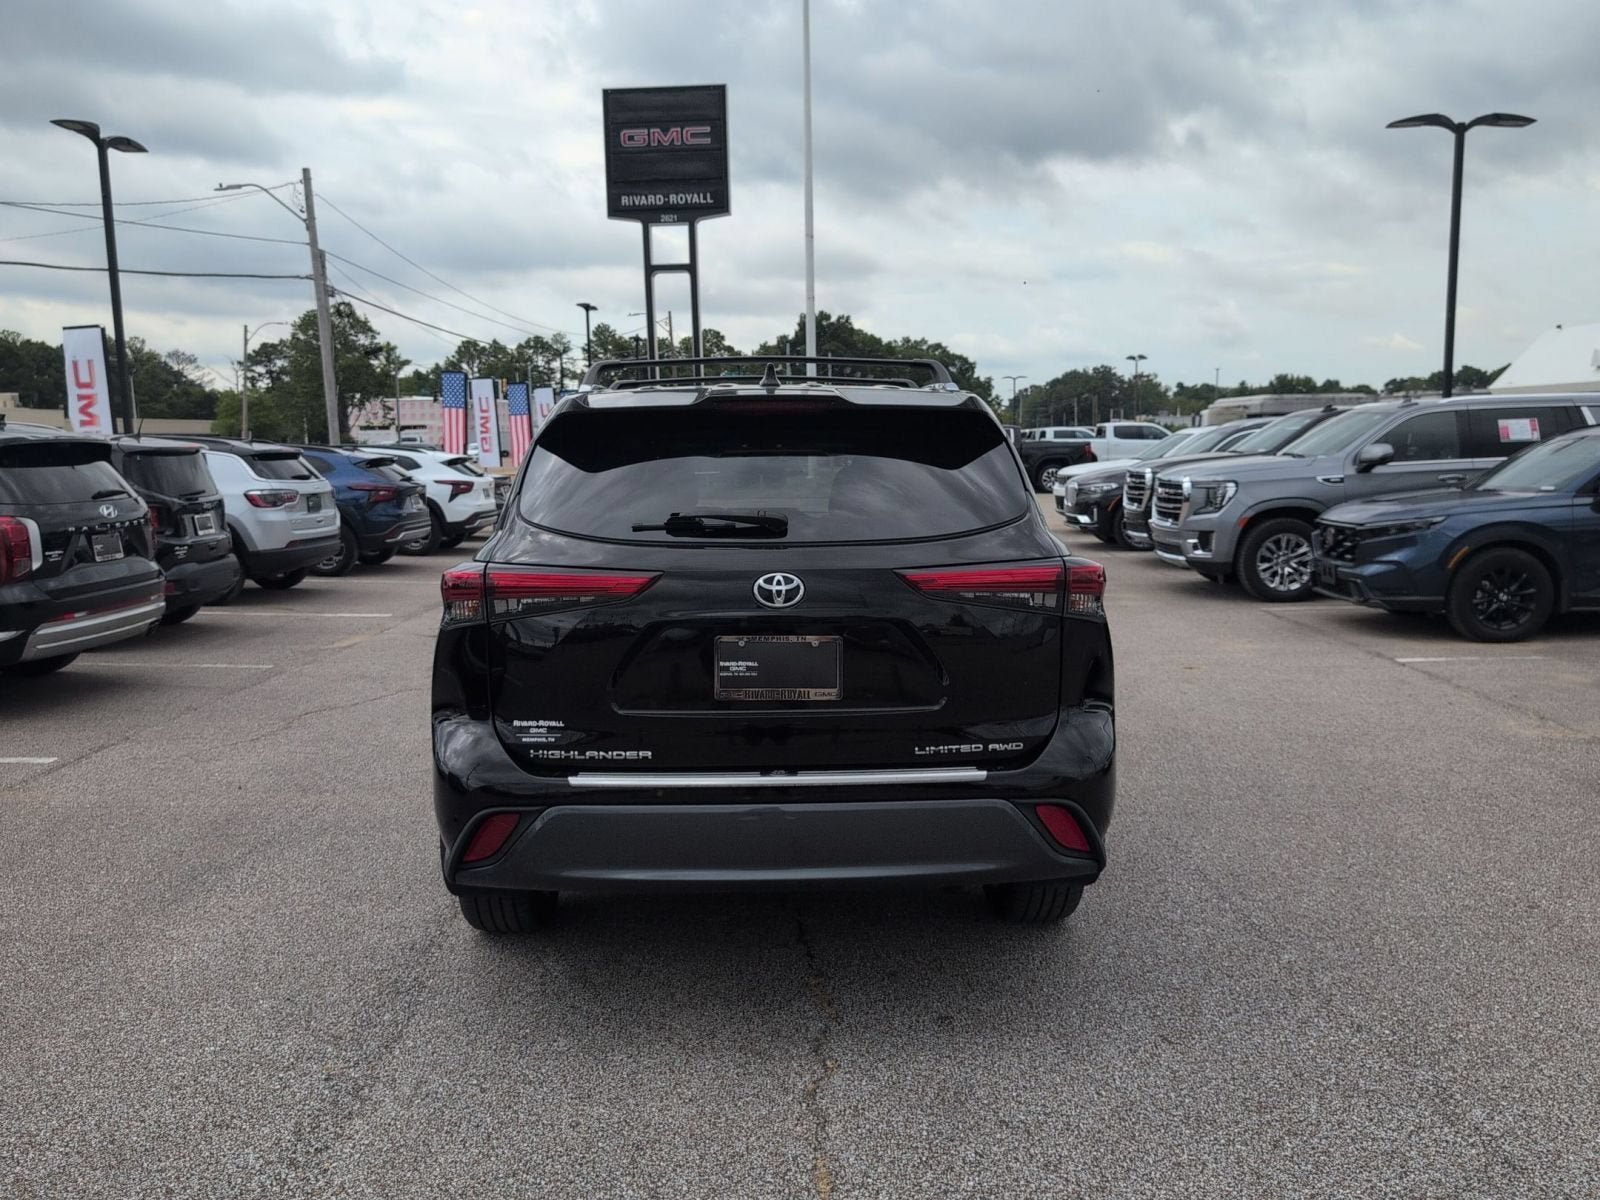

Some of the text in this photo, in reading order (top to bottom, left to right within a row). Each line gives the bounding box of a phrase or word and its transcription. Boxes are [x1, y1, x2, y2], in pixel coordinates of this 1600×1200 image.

[620, 126, 711, 147] GMC
[621, 192, 714, 206] RIVARD-ROYALL
[71, 359, 101, 432] MC
[478, 396, 492, 453] GMC
[530, 749, 652, 759] HIGHLANDER
[915, 742, 1024, 754] LIMITED AWD
